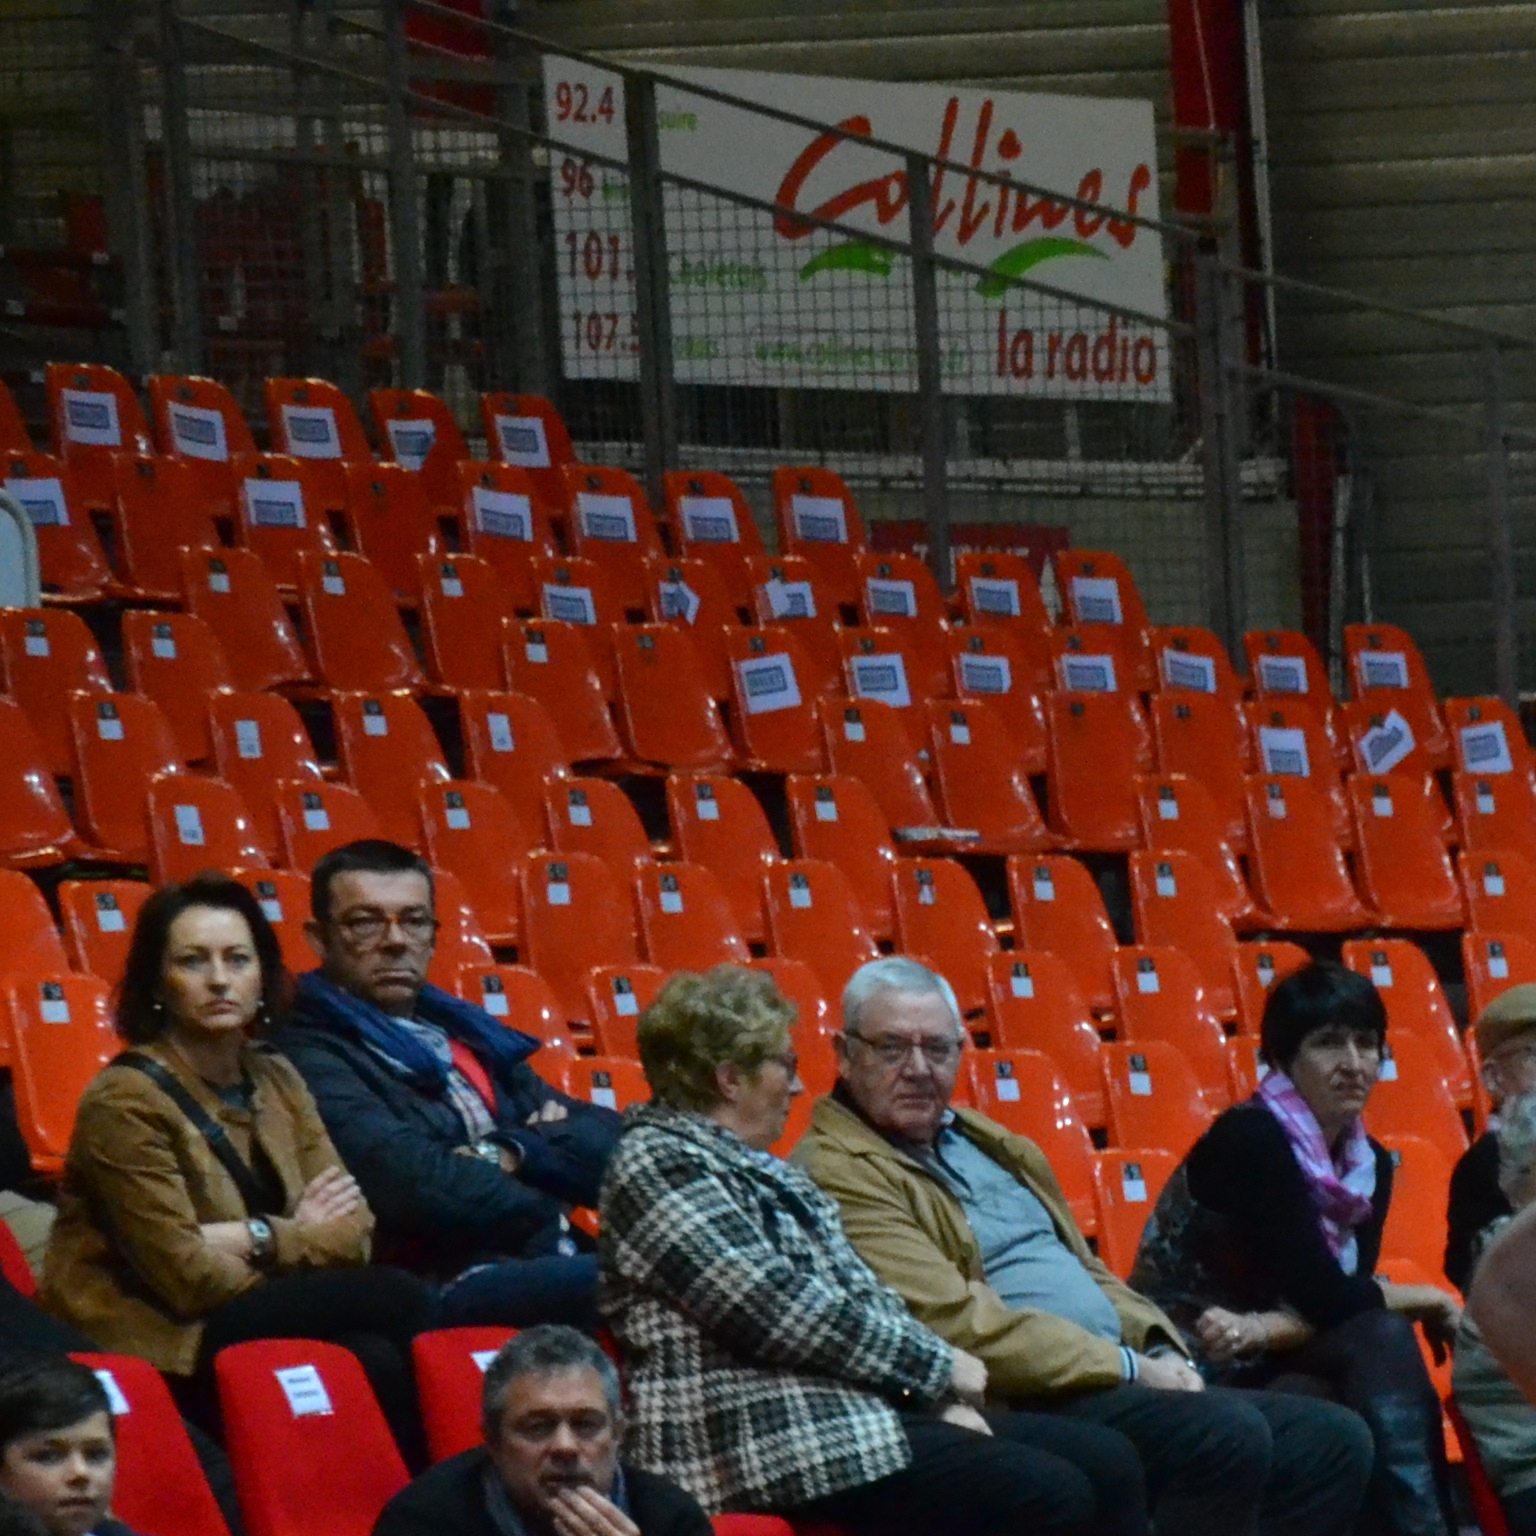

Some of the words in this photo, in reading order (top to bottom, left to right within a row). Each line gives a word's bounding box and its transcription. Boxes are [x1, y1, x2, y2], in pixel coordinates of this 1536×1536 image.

[555, 81, 614, 125] 92.4
[772, 97, 1151, 248] Collines
[998, 308, 1034, 380] la
[1046, 312, 1157, 386] radio
